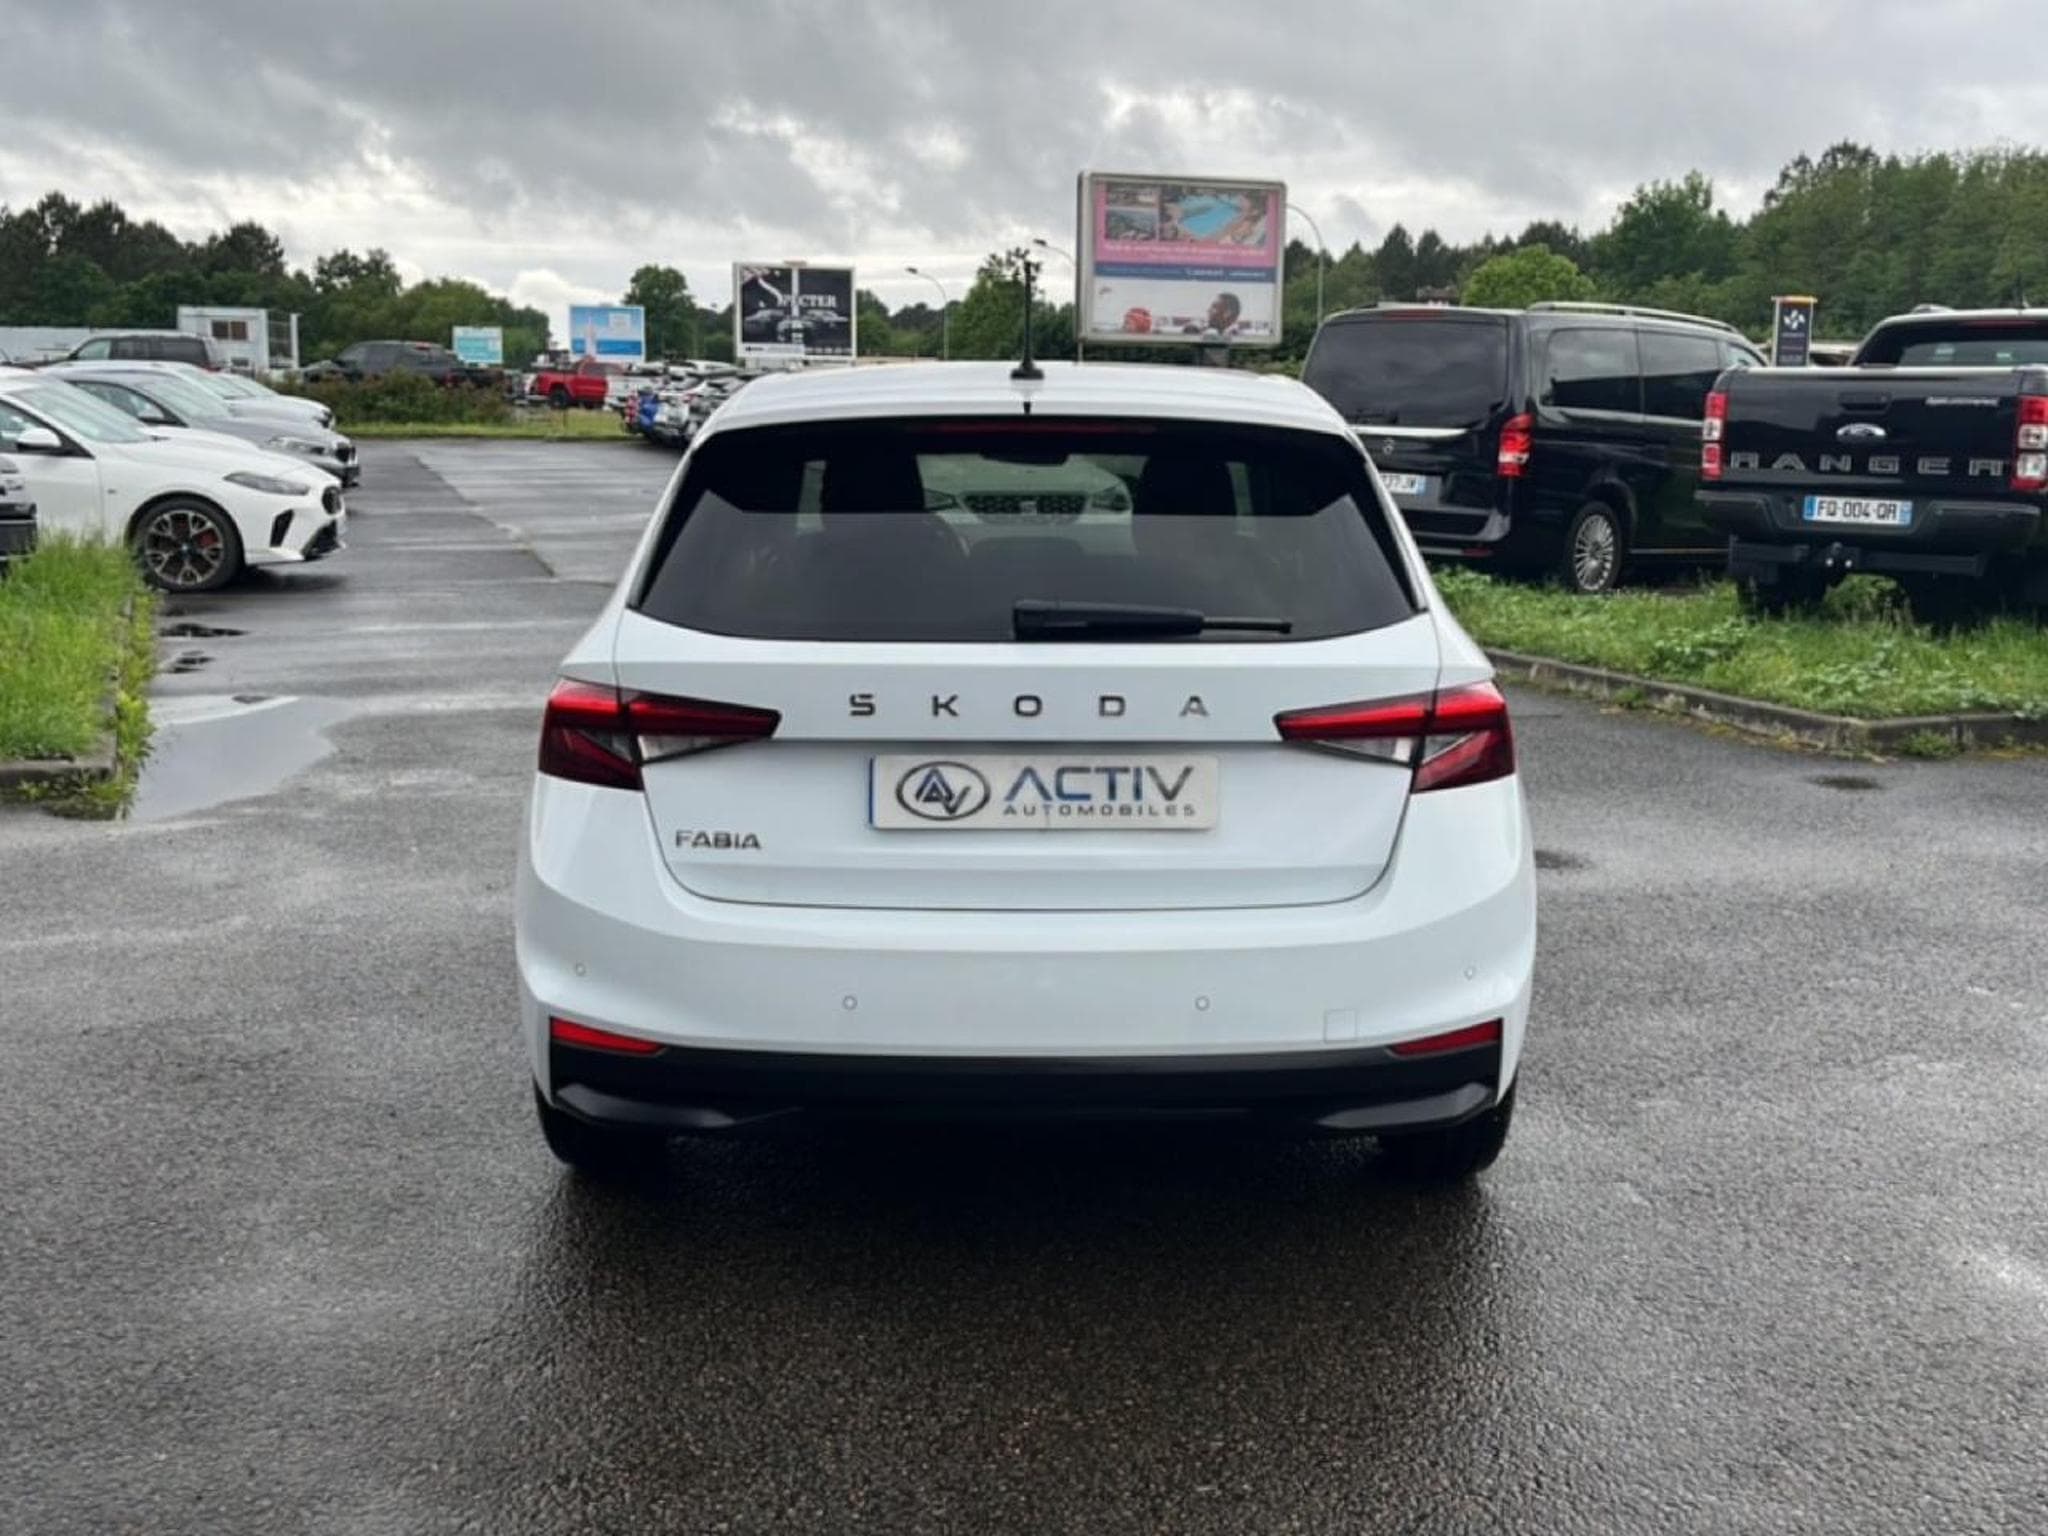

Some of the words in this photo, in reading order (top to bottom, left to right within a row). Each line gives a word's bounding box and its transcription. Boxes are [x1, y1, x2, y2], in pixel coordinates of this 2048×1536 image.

[1730, 452, 2004, 476] RANGER
[849, 693, 1210, 718] SKODA
[1003, 765, 1195, 802] ACTIV
[1003, 803, 1196, 817] AUTOMOBILES
[675, 830, 762, 850] FABIA
